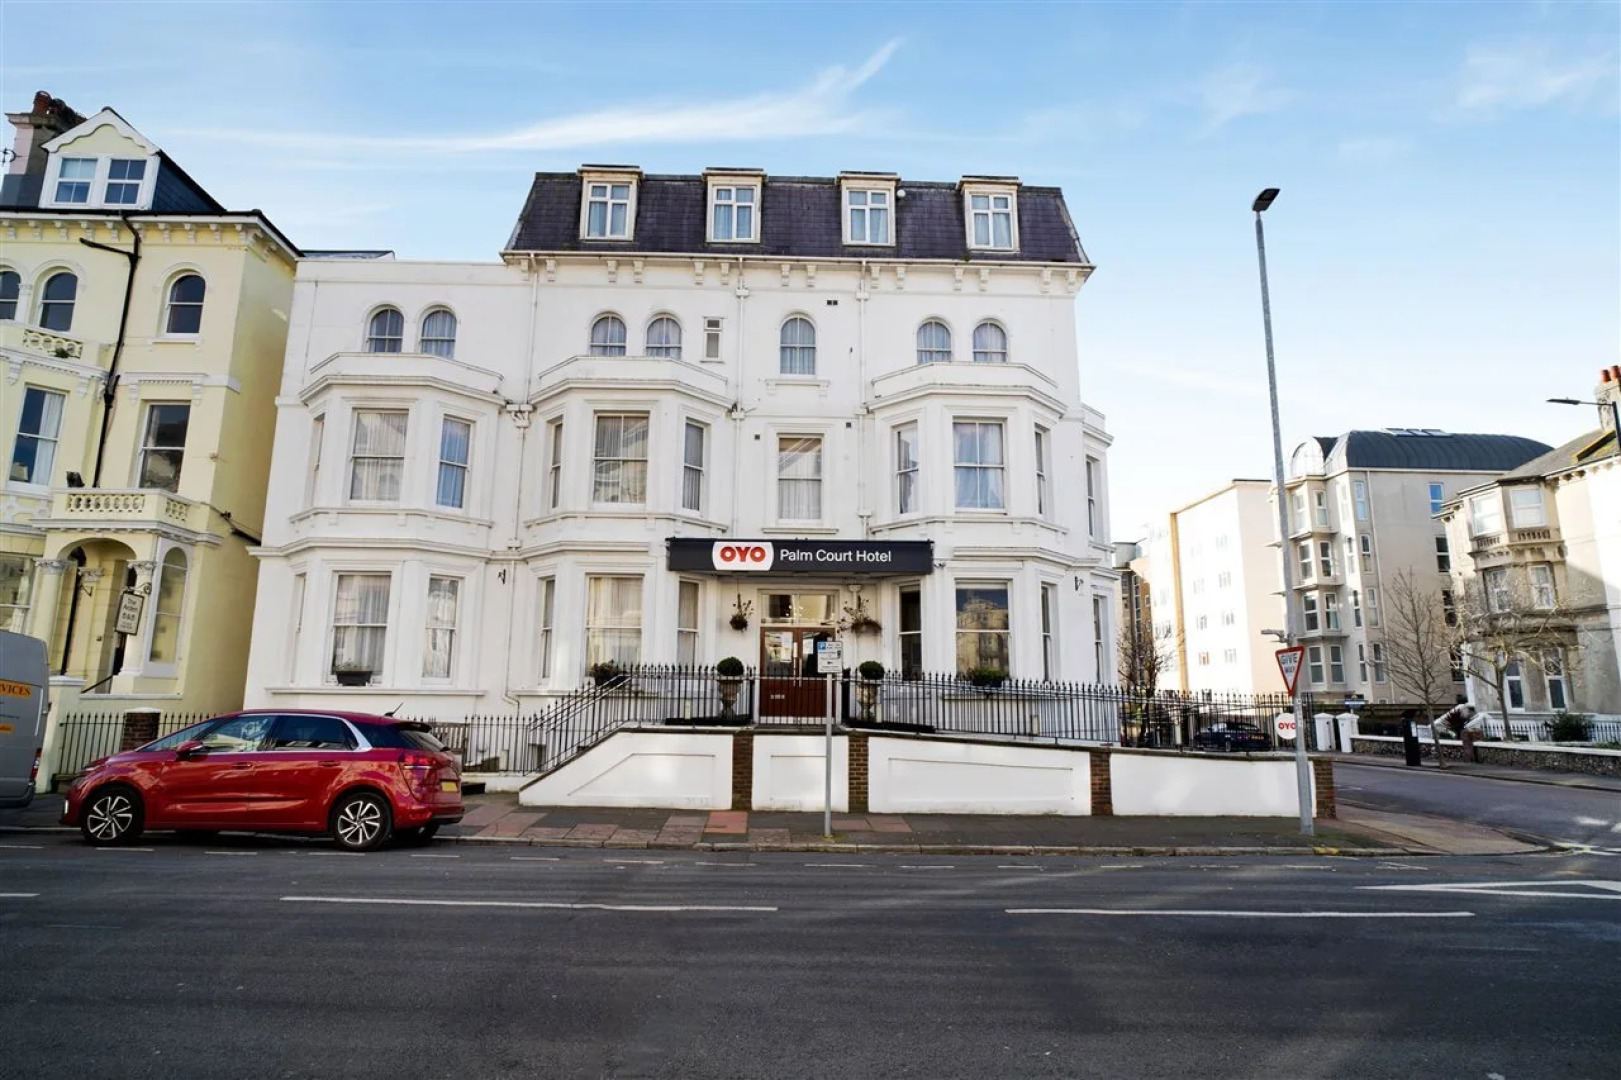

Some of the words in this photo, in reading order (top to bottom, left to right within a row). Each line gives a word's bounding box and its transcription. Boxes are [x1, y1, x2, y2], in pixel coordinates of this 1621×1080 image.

[720, 546, 766, 562] OYO
[780, 549, 813, 561] Palm
[816, 549, 852, 562] Court
[856, 550, 892, 562] Hotel
[1281, 653, 1298, 665] GIVE
[0, 684, 30, 696] VICES
[1278, 722, 1297, 730] OYO
